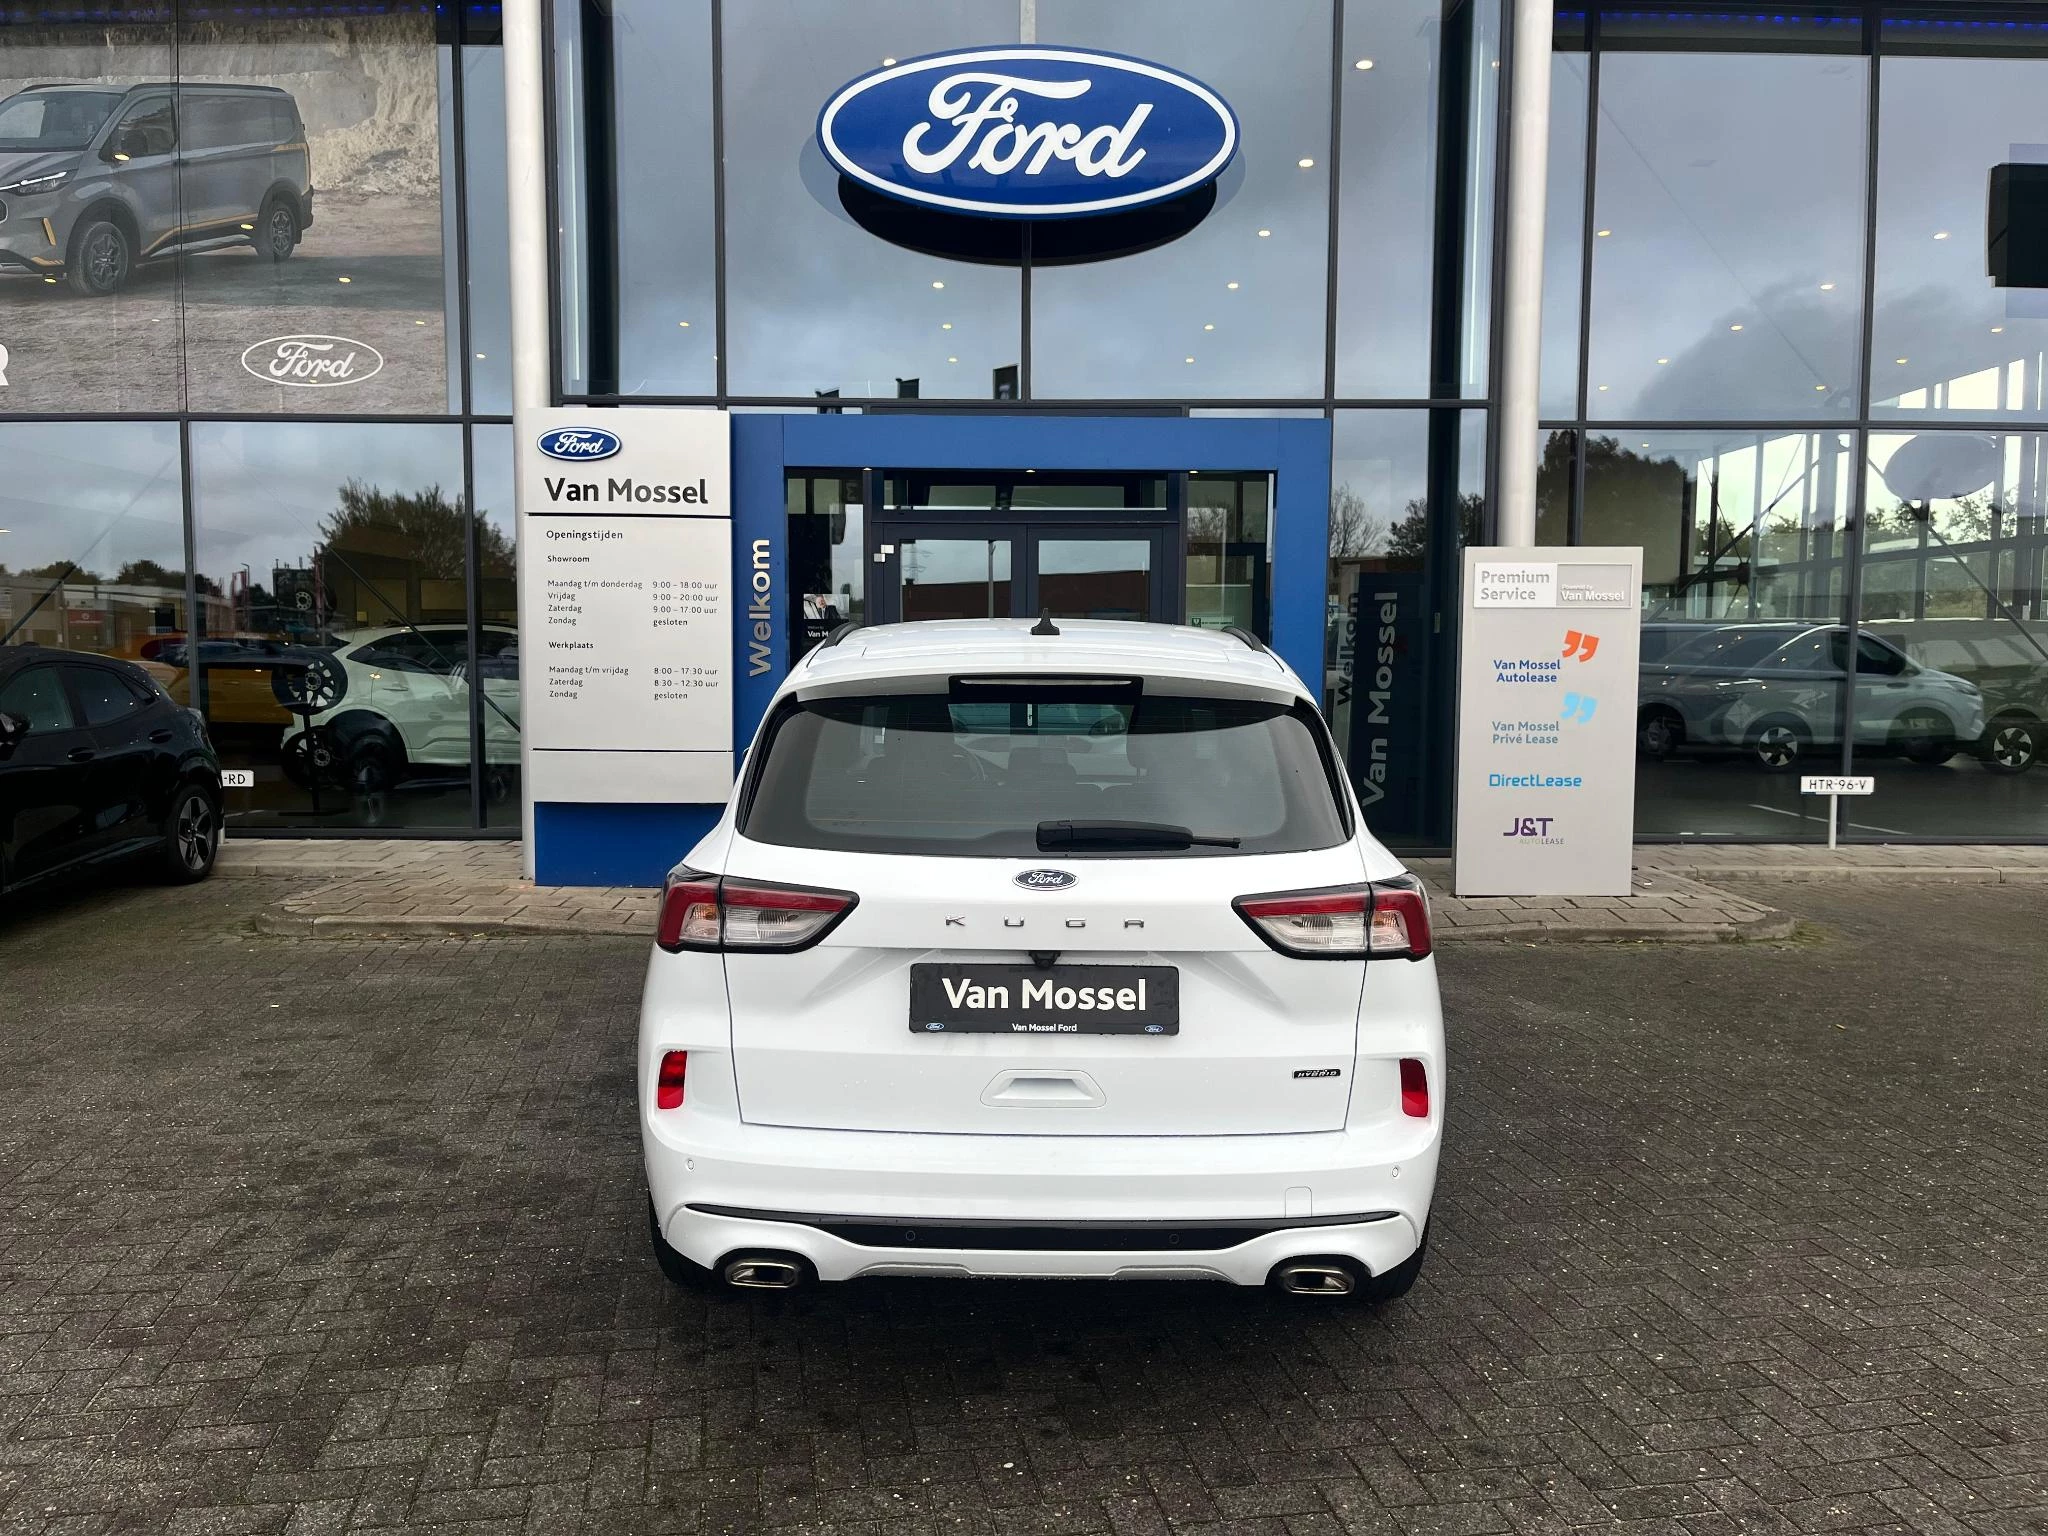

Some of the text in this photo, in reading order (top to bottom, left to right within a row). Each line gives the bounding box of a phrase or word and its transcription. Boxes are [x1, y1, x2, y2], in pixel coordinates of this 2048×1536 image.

[903, 72, 1154, 178] Ford
[269, 341, 356, 379] Ford
[554, 432, 604, 453] Ford
[544, 478, 709, 504] Van Mossel
[546, 530, 623, 541] Openingstijden
[547, 555, 590, 563] Showroom
[1481, 570, 1550, 584] Premium
[548, 580, 582, 589] Maandag
[584, 580, 599, 588] t/m
[601, 580, 643, 590] donderdag
[548, 592, 576, 601] Vrijdag
[1480, 587, 1536, 600] Service
[1561, 591, 1625, 601] Van Mossel
[548, 604, 582, 614] Zaterdag
[749, 538, 772, 677] Welkom
[548, 617, 688, 627] Zondag gesloten
[808, 630, 821, 638] Van
[548, 641, 594, 650] Werkplaats
[1337, 592, 1360, 706] Welkom
[1493, 659, 1561, 670] Van Mossel
[549, 666, 583, 675] Maandag
[585, 666, 600, 674] t/m
[602, 666, 629, 676] vrijdag
[549, 678, 583, 687] Zaterdag
[1496, 672, 1557, 683] Autolease
[549, 690, 688, 700] Zondag gesloten
[1362, 592, 1398, 807] Van Mossel
[1492, 721, 1560, 731] Van Mossel
[1492, 733, 1559, 744] Privé Lease
[1489, 774, 1583, 787] DirectLease
[1809, 779, 1867, 790] HTR-96-V
[1503, 818, 1554, 836] J&T
[942, 978, 1146, 1011] Van Mossel
[1012, 1023, 1077, 1032] Van Mossel Ford
